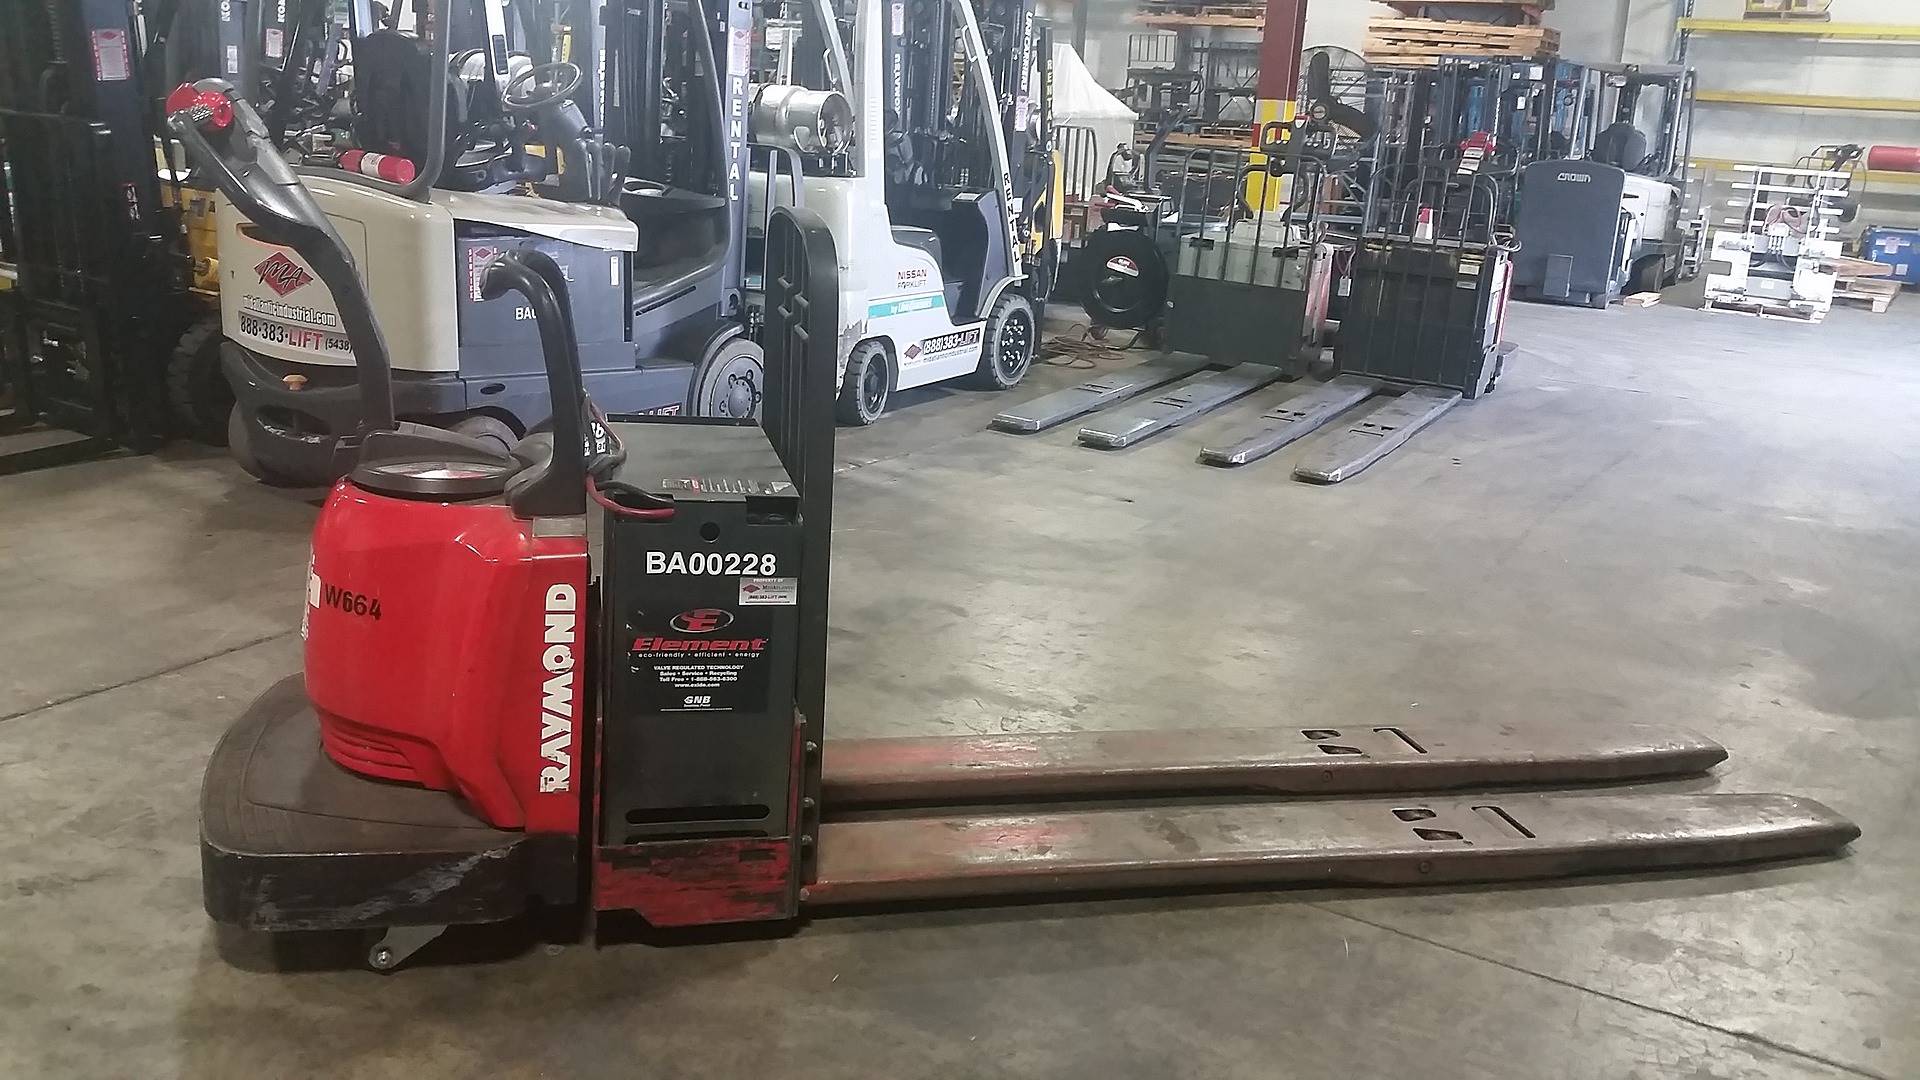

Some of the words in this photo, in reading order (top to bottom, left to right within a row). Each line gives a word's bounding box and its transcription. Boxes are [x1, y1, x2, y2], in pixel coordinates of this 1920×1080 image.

[728, 77, 743, 201] RENTAL
[1003, 173, 1020, 263] RENTAL
[897, 269, 927, 280] NISSAN
[646, 551, 777, 576] BA00228
[325, 582, 382, 620] W664
[632, 637, 767, 652] Element
[539, 583, 577, 793] RAYMOND
[684, 695, 711, 704] GNB
